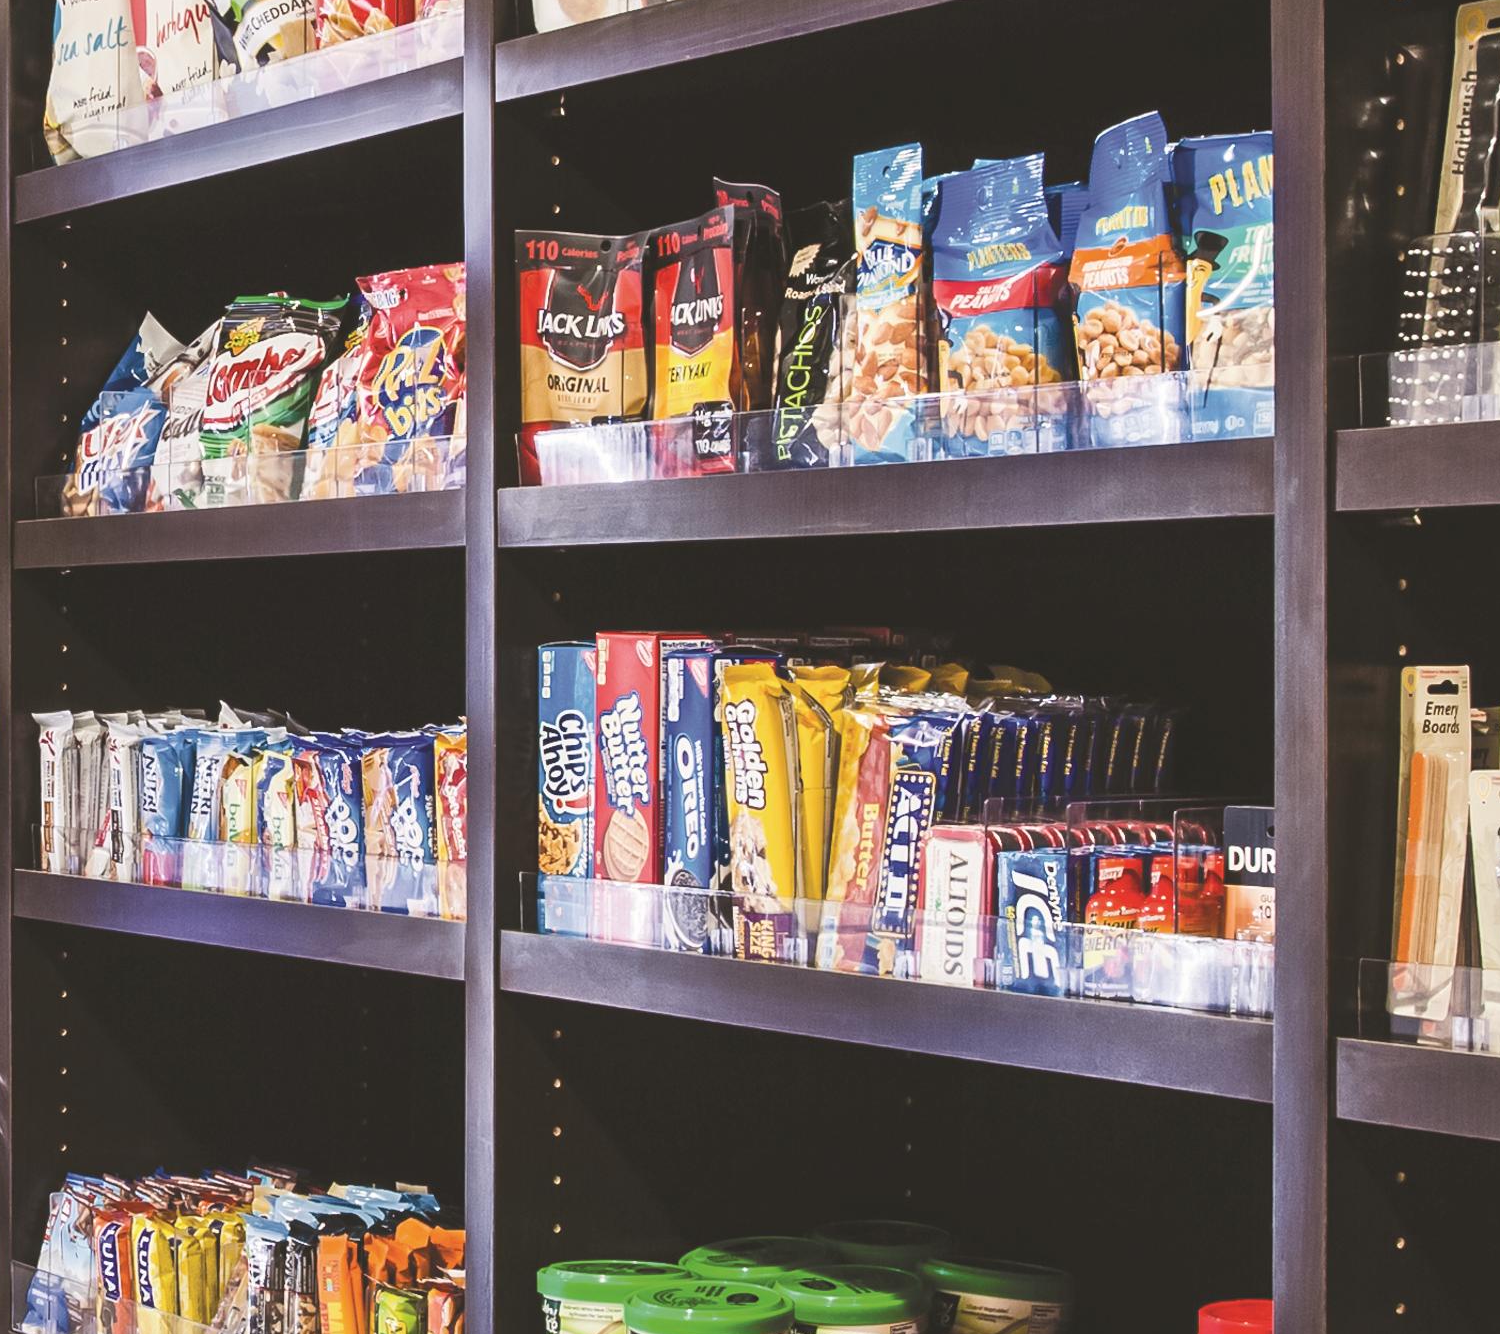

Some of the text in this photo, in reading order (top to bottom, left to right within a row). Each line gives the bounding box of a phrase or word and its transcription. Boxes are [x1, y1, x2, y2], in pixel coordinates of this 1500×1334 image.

[1452, 68, 1478, 176] Hairbrush
[527, 240, 599, 260] 110 Calories
[658, 232, 681, 256] 110
[967, 243, 1032, 271] PLANTERS
[1083, 269, 1130, 288] PEANUTS
[950, 282, 1013, 310] PEANUTS
[547, 374, 609, 394] ORIGINAL
[778, 305, 822, 461] PISTACHIOS
[559, 713, 587, 792] Chips
[600, 712, 634, 816] Butter
[615, 694, 649, 803] Nutter
[733, 700, 766, 809] Golden
[1422, 718, 1460, 736] Boards
[676, 736, 699, 859] OREO
[944, 851, 969, 977] ALTOIDS
[1011, 869, 1060, 982] ICE
[101, 1223, 119, 1298] LUNA
[139, 1230, 154, 1305] LUNA
